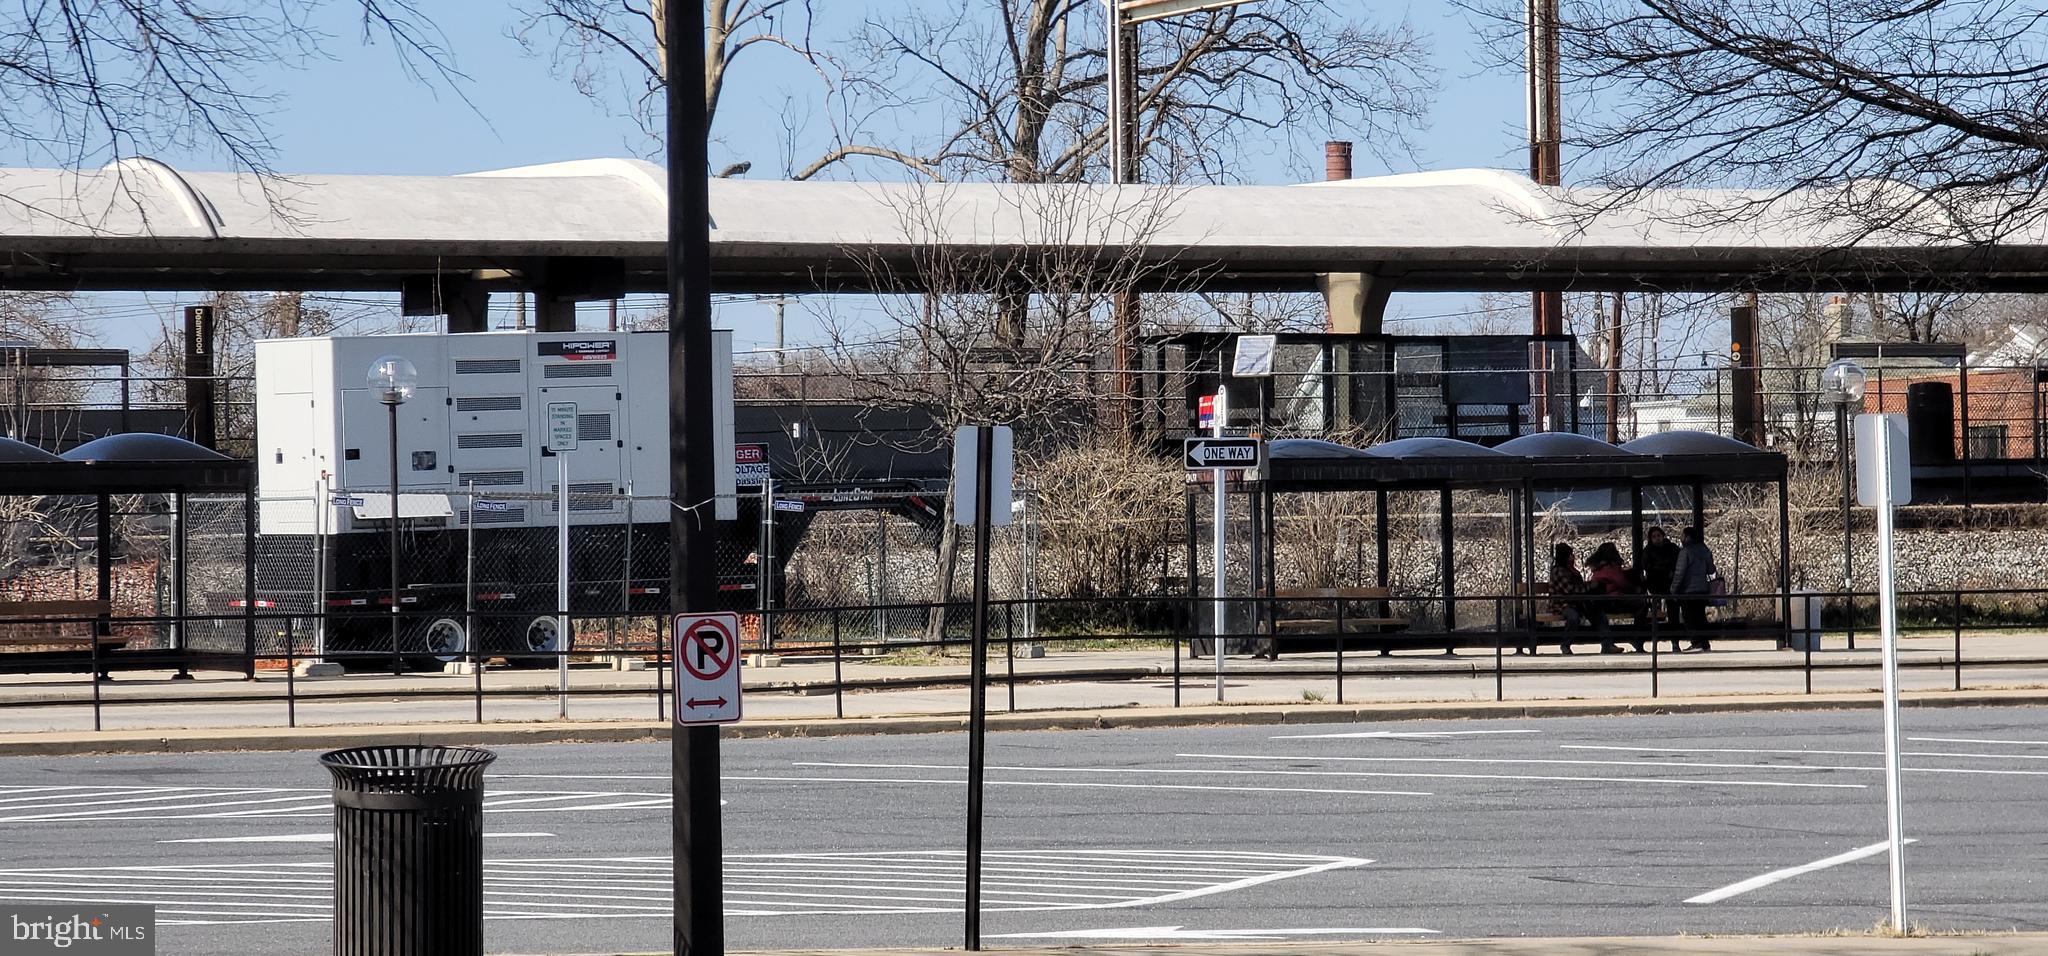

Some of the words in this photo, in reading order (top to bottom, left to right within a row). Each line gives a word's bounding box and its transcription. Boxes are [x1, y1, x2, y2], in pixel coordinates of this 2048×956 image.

[194, 308, 204, 354] Deanwood
[562, 341, 610, 350] HIPOWER
[736, 449, 760, 459] GER
[1203, 447, 1225, 459] ONE
[1228, 447, 1251, 459] WAY
[735, 465, 769, 474] OLTAGE
[696, 630, 724, 670] P
